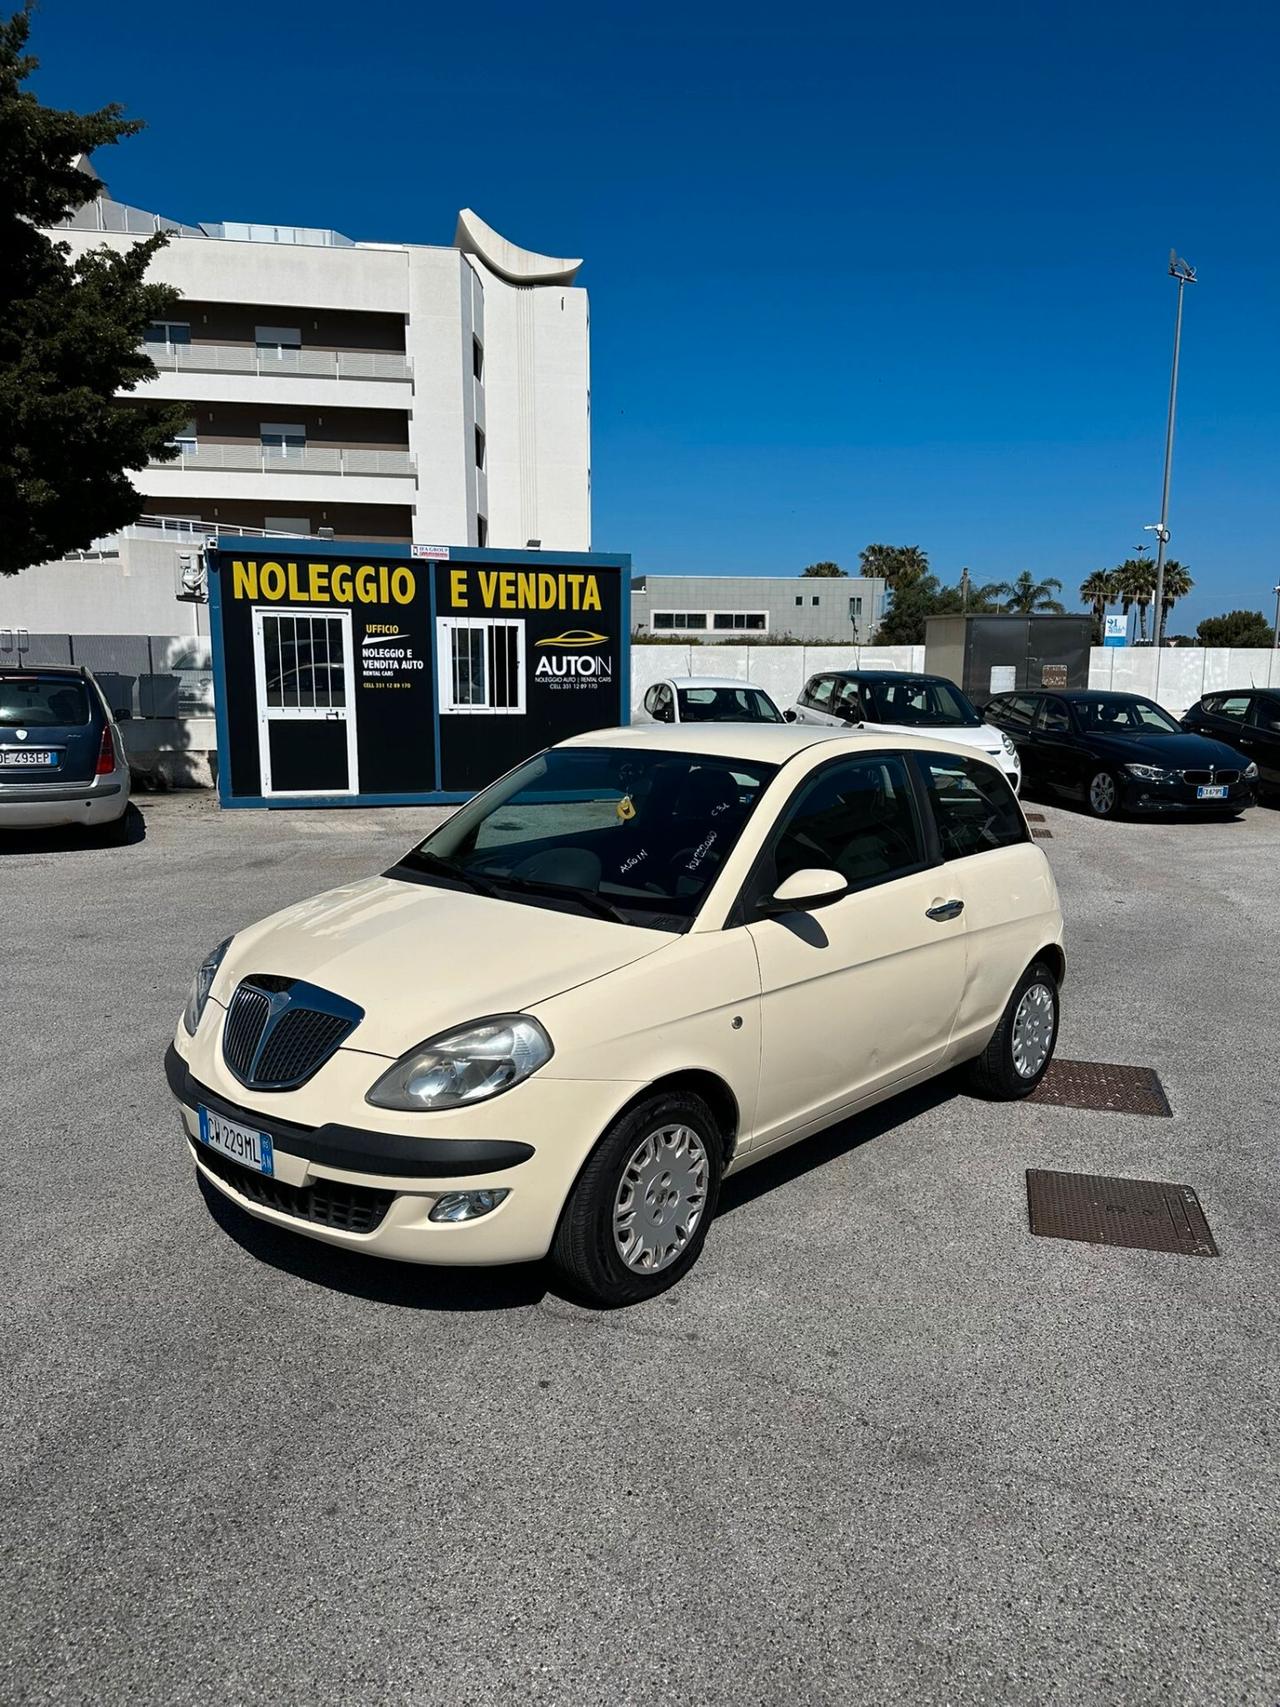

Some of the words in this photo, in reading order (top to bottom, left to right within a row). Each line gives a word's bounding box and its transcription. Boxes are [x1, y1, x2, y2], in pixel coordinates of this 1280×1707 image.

[232, 561, 416, 604] NOLEGGIO
[450, 570, 468, 608] E
[478, 571, 602, 611] VENDITA
[366, 624, 399, 634] UFFICIO
[362, 648, 405, 658] NOLEGGIO
[407, 649, 413, 658] E
[362, 659, 400, 669] VENDITA
[401, 660, 424, 670] AUTO
[534, 655, 612, 676] AUTOIN
[15, 752, 49, 764] 493EP
[208, 1117, 221, 1145] CW
[223, 1125, 261, 1164] 229ML
